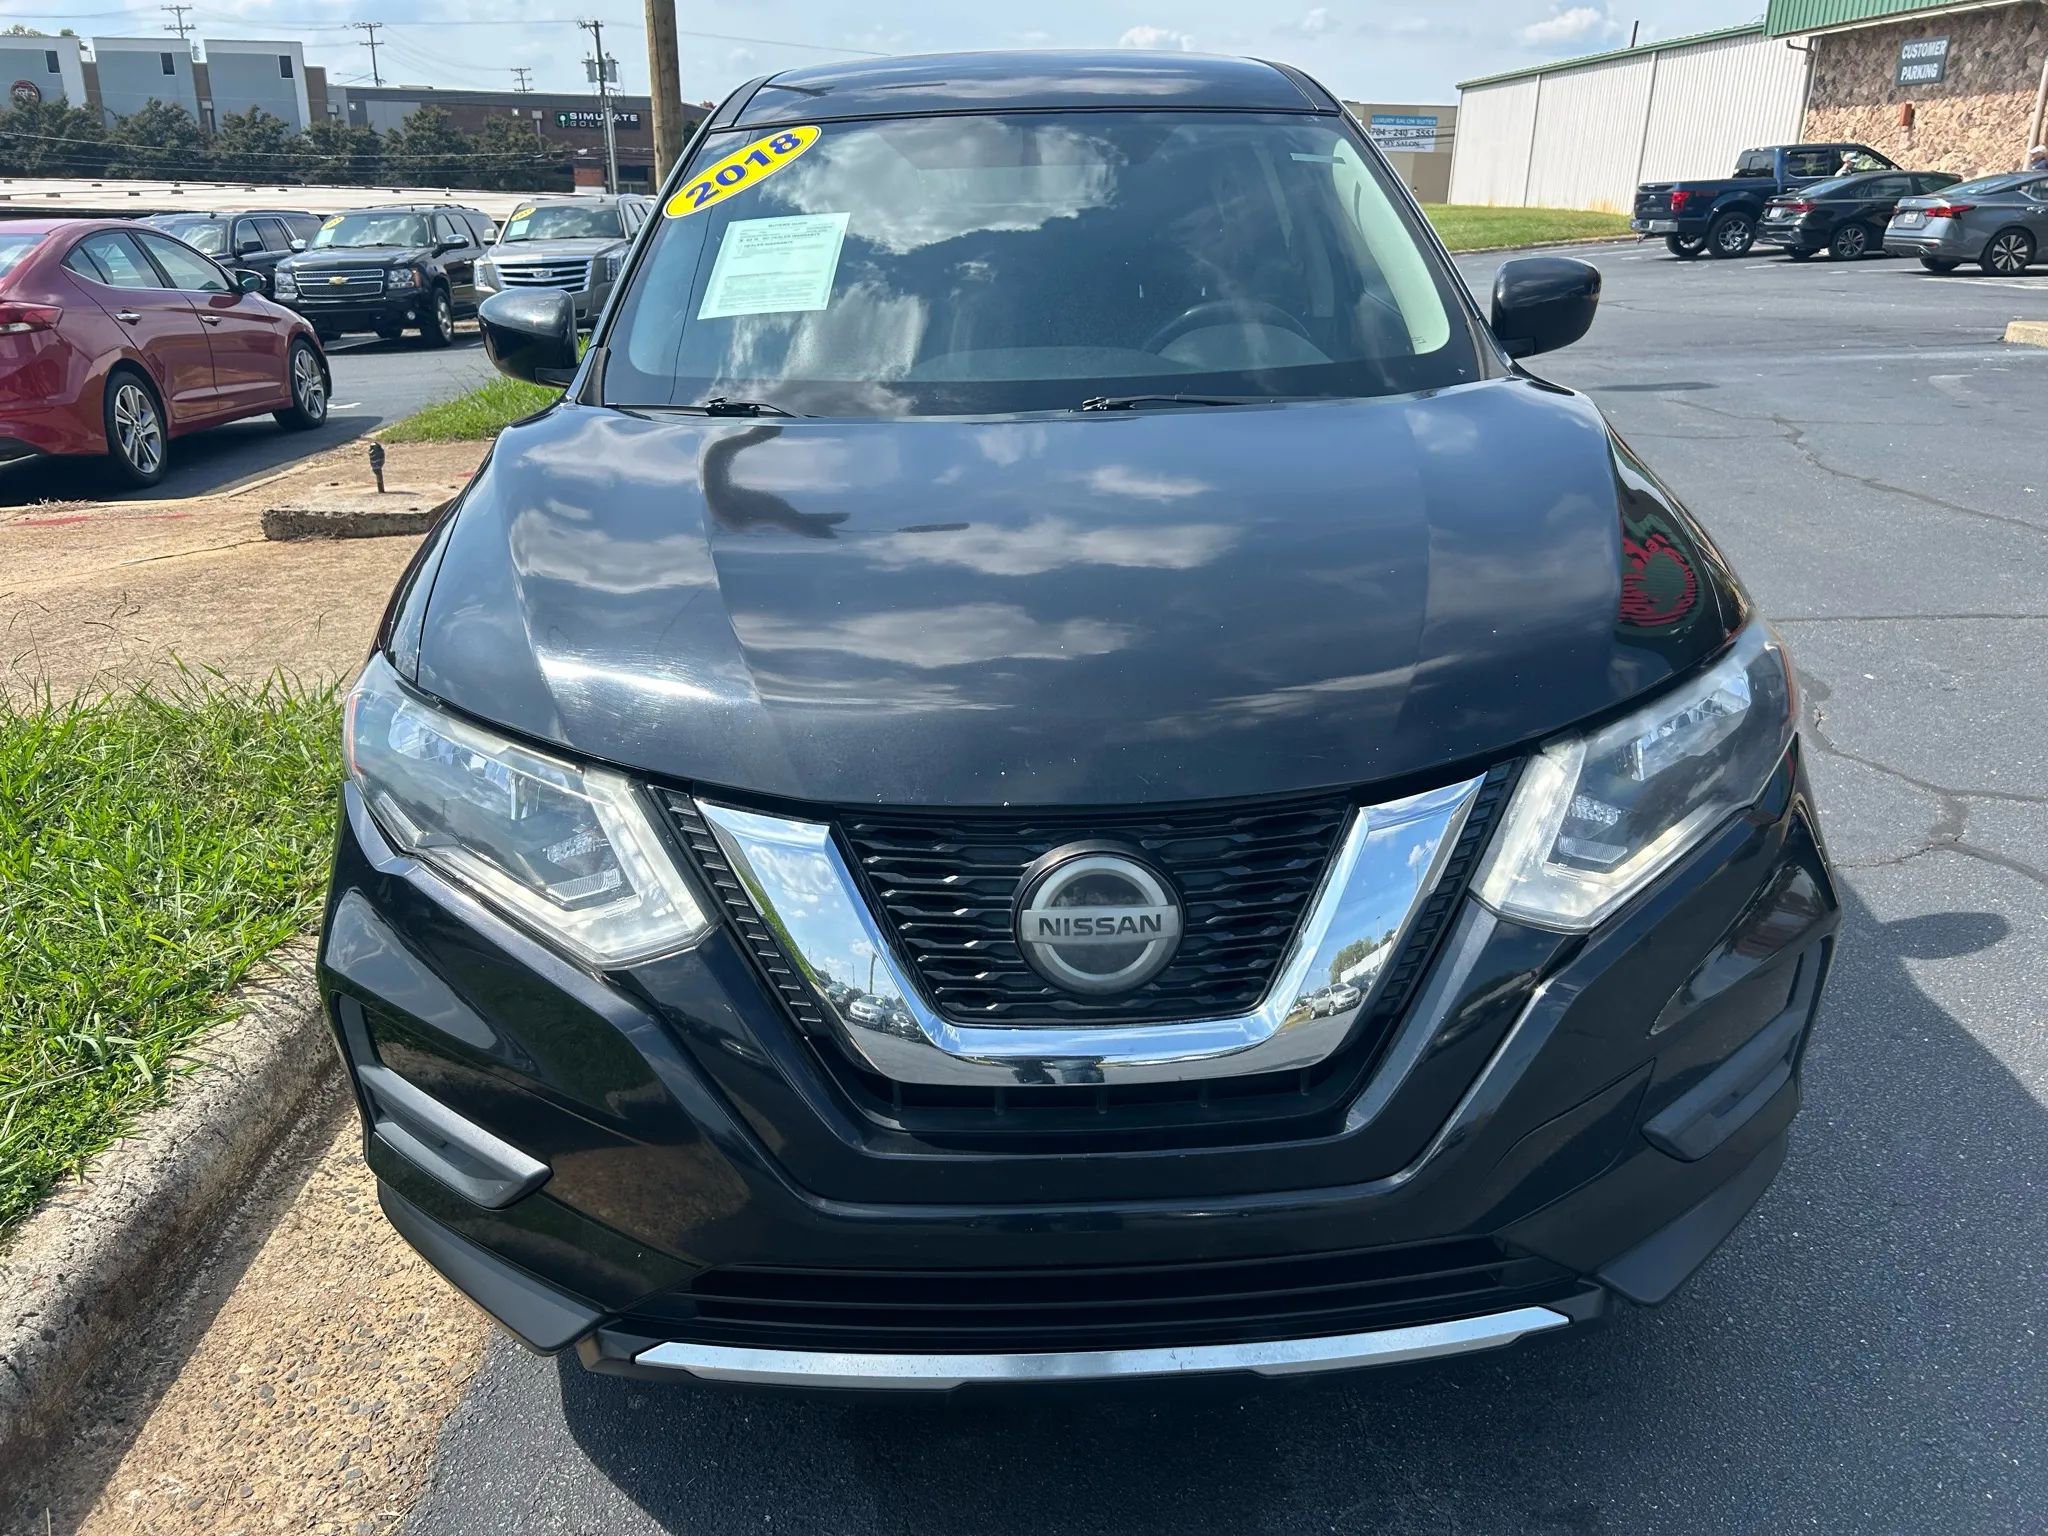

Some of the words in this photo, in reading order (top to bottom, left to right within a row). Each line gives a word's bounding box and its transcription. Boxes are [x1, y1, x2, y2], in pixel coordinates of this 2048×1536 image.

[1902, 40, 1947, 59] CUSTOMER
[1900, 63, 1938, 80] PARKING
[569, 112, 638, 121] SIMUATE
[686, 133, 804, 209] 2018
[1038, 913, 1162, 937] NISSAN
